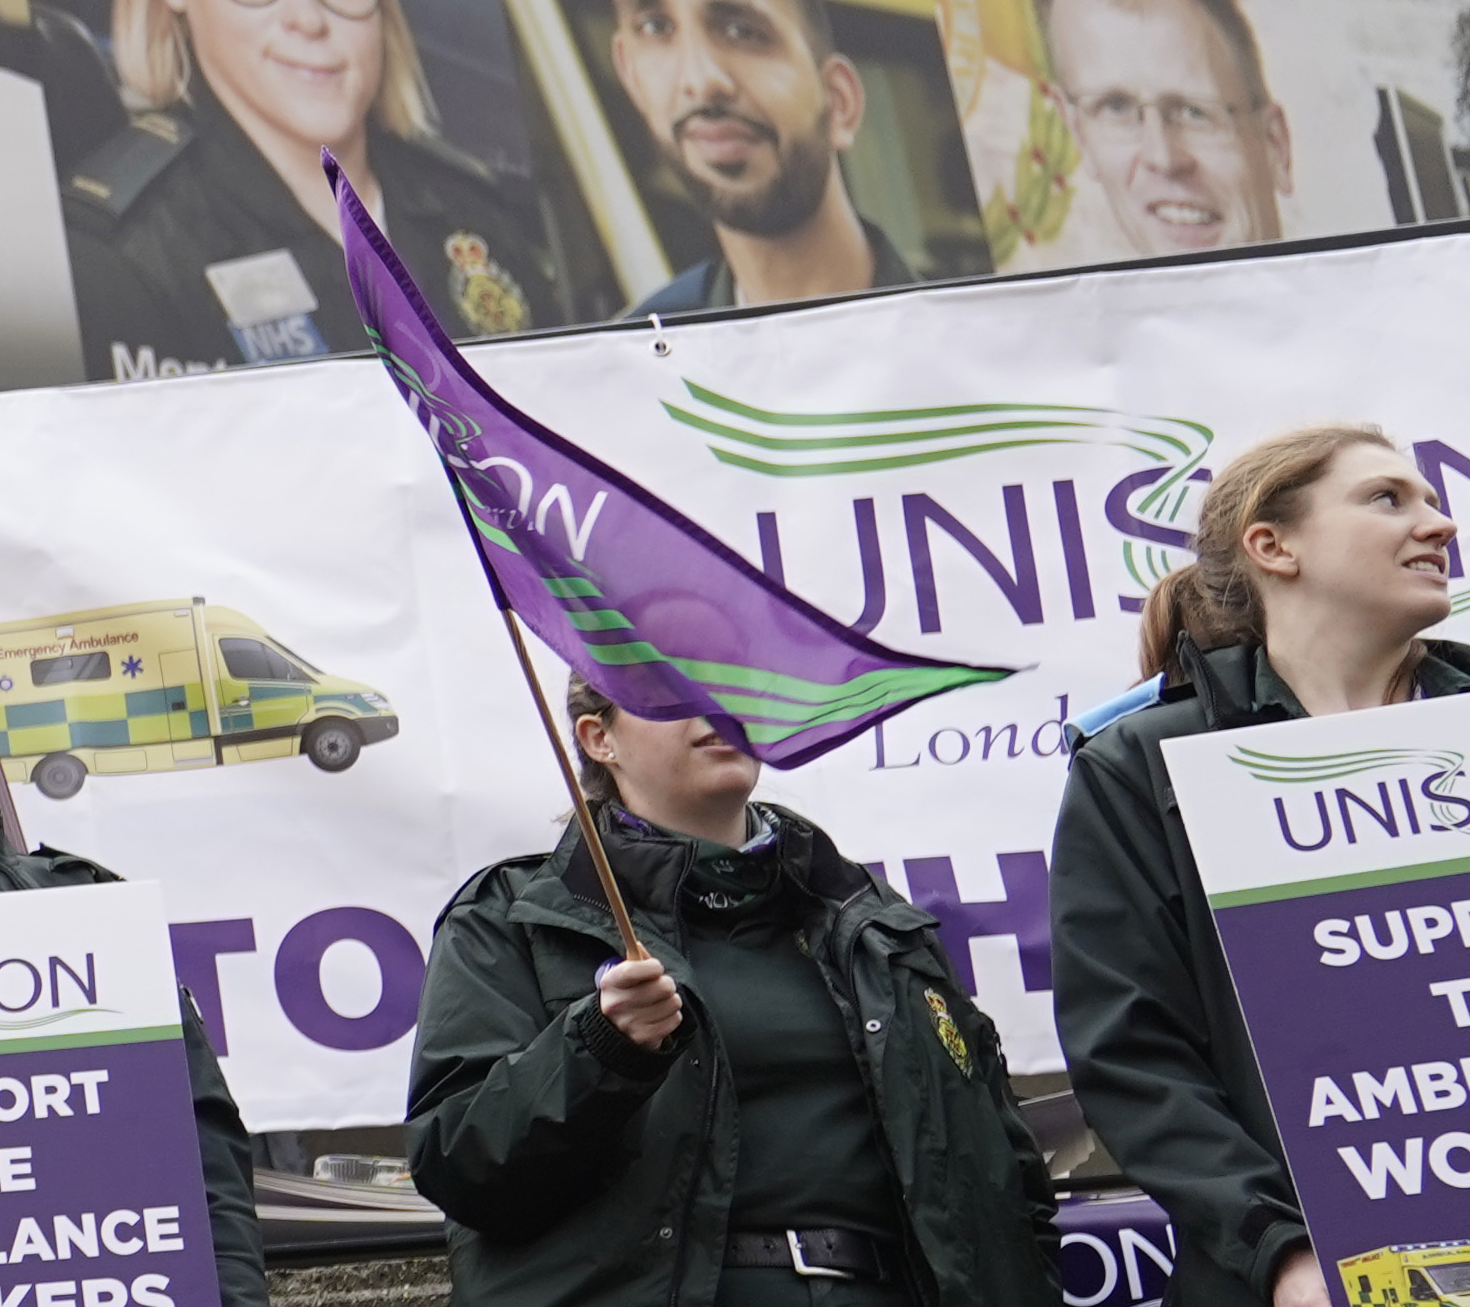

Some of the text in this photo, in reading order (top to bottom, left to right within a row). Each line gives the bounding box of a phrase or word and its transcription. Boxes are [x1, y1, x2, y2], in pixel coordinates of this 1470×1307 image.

[240, 316, 316, 363] NHS
[68, 629, 140, 651] Ambulance
[870, 696, 1070, 772] Lond
